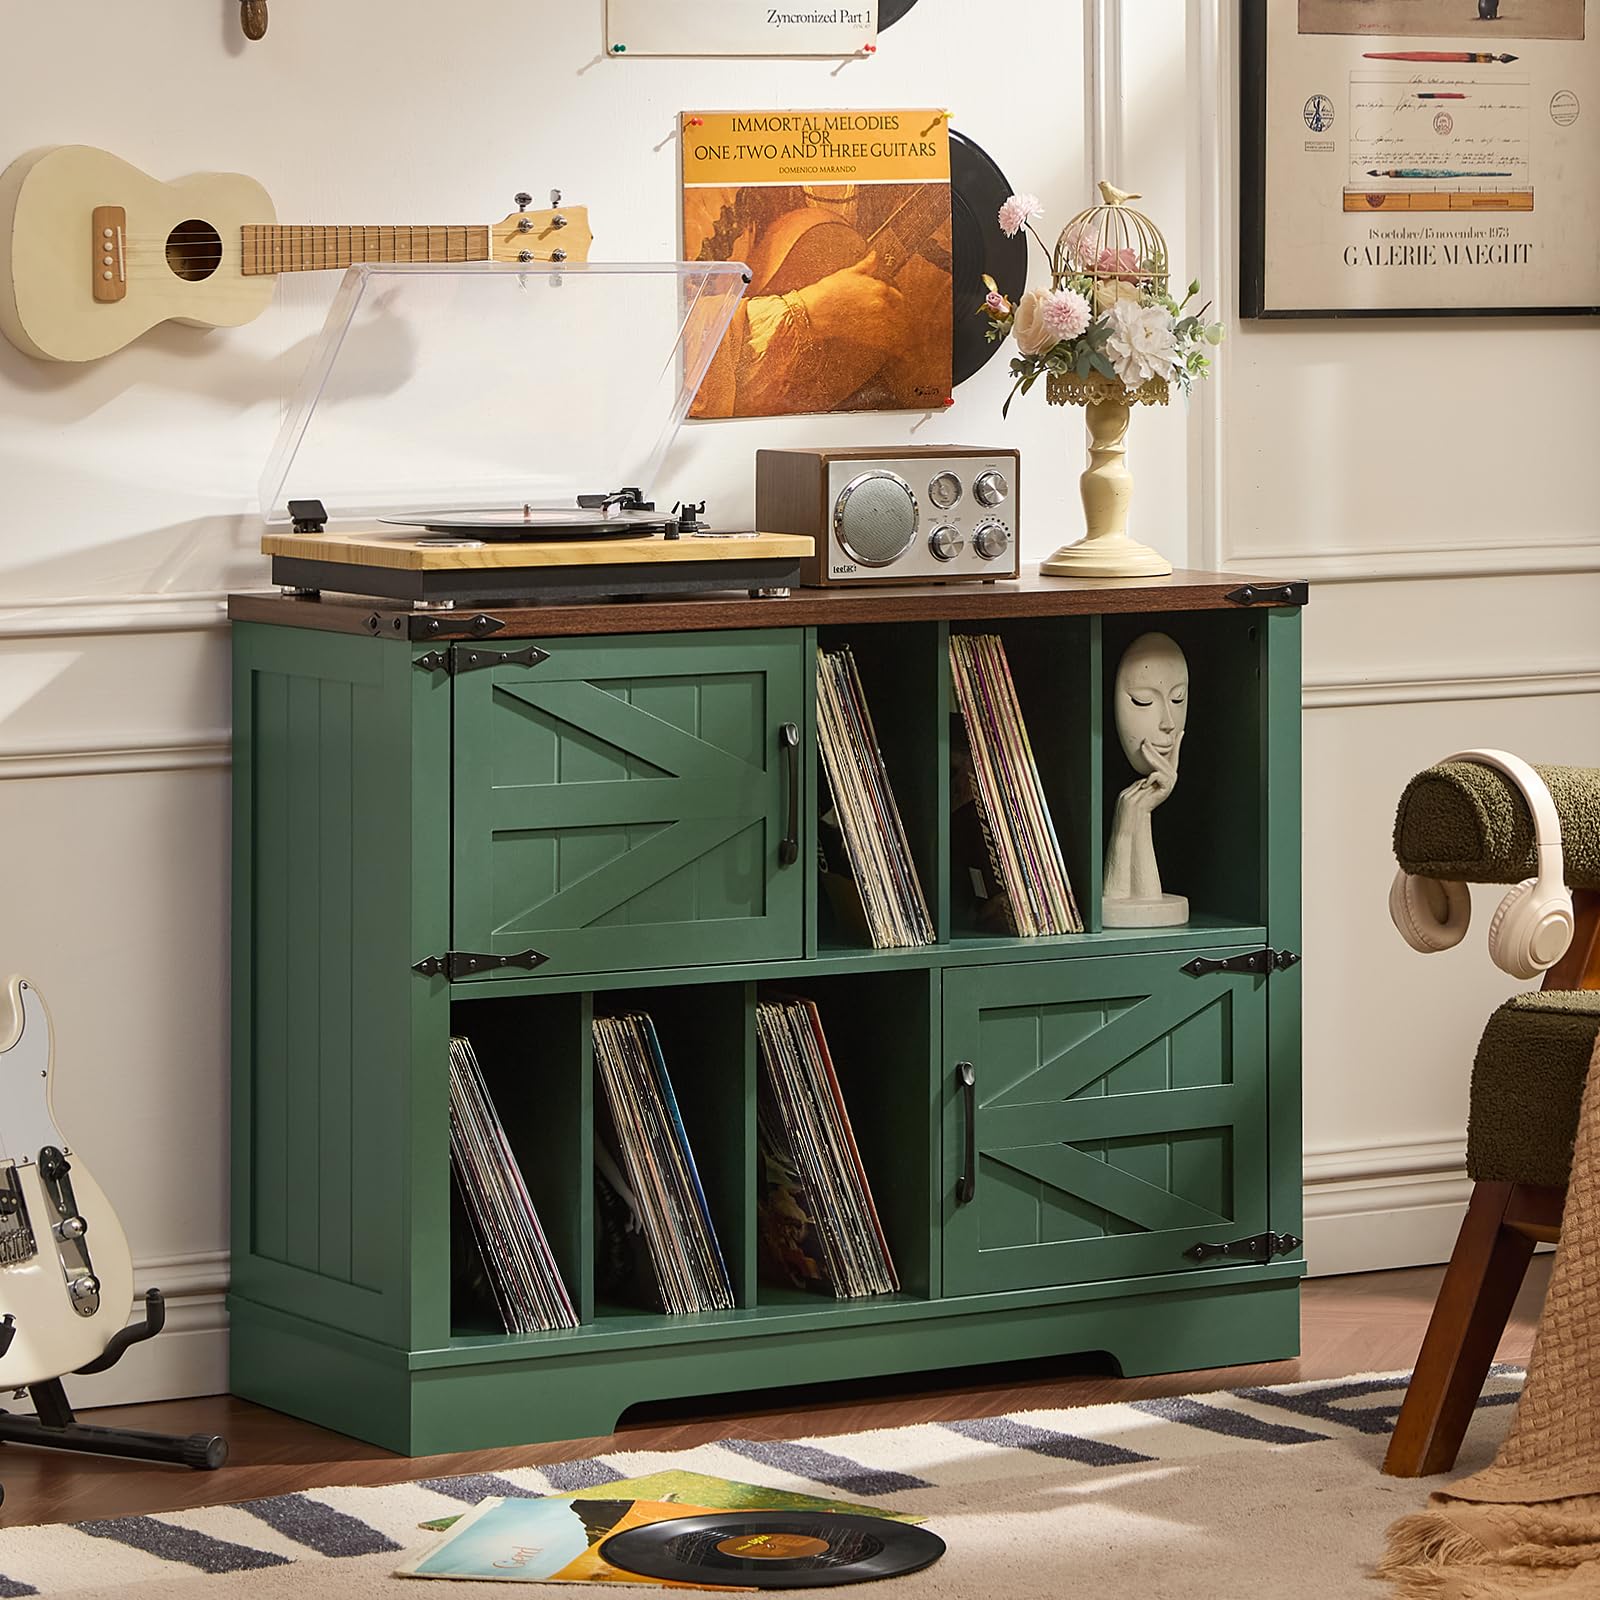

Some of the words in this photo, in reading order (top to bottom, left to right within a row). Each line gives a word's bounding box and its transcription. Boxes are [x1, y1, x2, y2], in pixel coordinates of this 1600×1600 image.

[767, 9, 837, 28] Zyncronized
[840, 10, 862, 24] Part
[866, 10, 872, 24] 1
[731, 116, 821, 132] IMMORTAL
[824, 115, 900, 131] MELODIES
[801, 130, 831, 145] FOR
[780, 144, 817, 159] AND
[820, 144, 869, 158] THREE
[870, 141, 937, 158] GUITARS
[778, 166, 819, 175] DOMENICO
[819, 165, 857, 174] MARANDO
[1435, 227, 1488, 239] novembre
[1489, 226, 1510, 239] 1973
[1343, 245, 1436, 267] GALERIE
[1442, 243, 1533, 265] MAEGHT
[968, 771, 986, 820] HERB
[979, 820, 1007, 891] ALPERT
